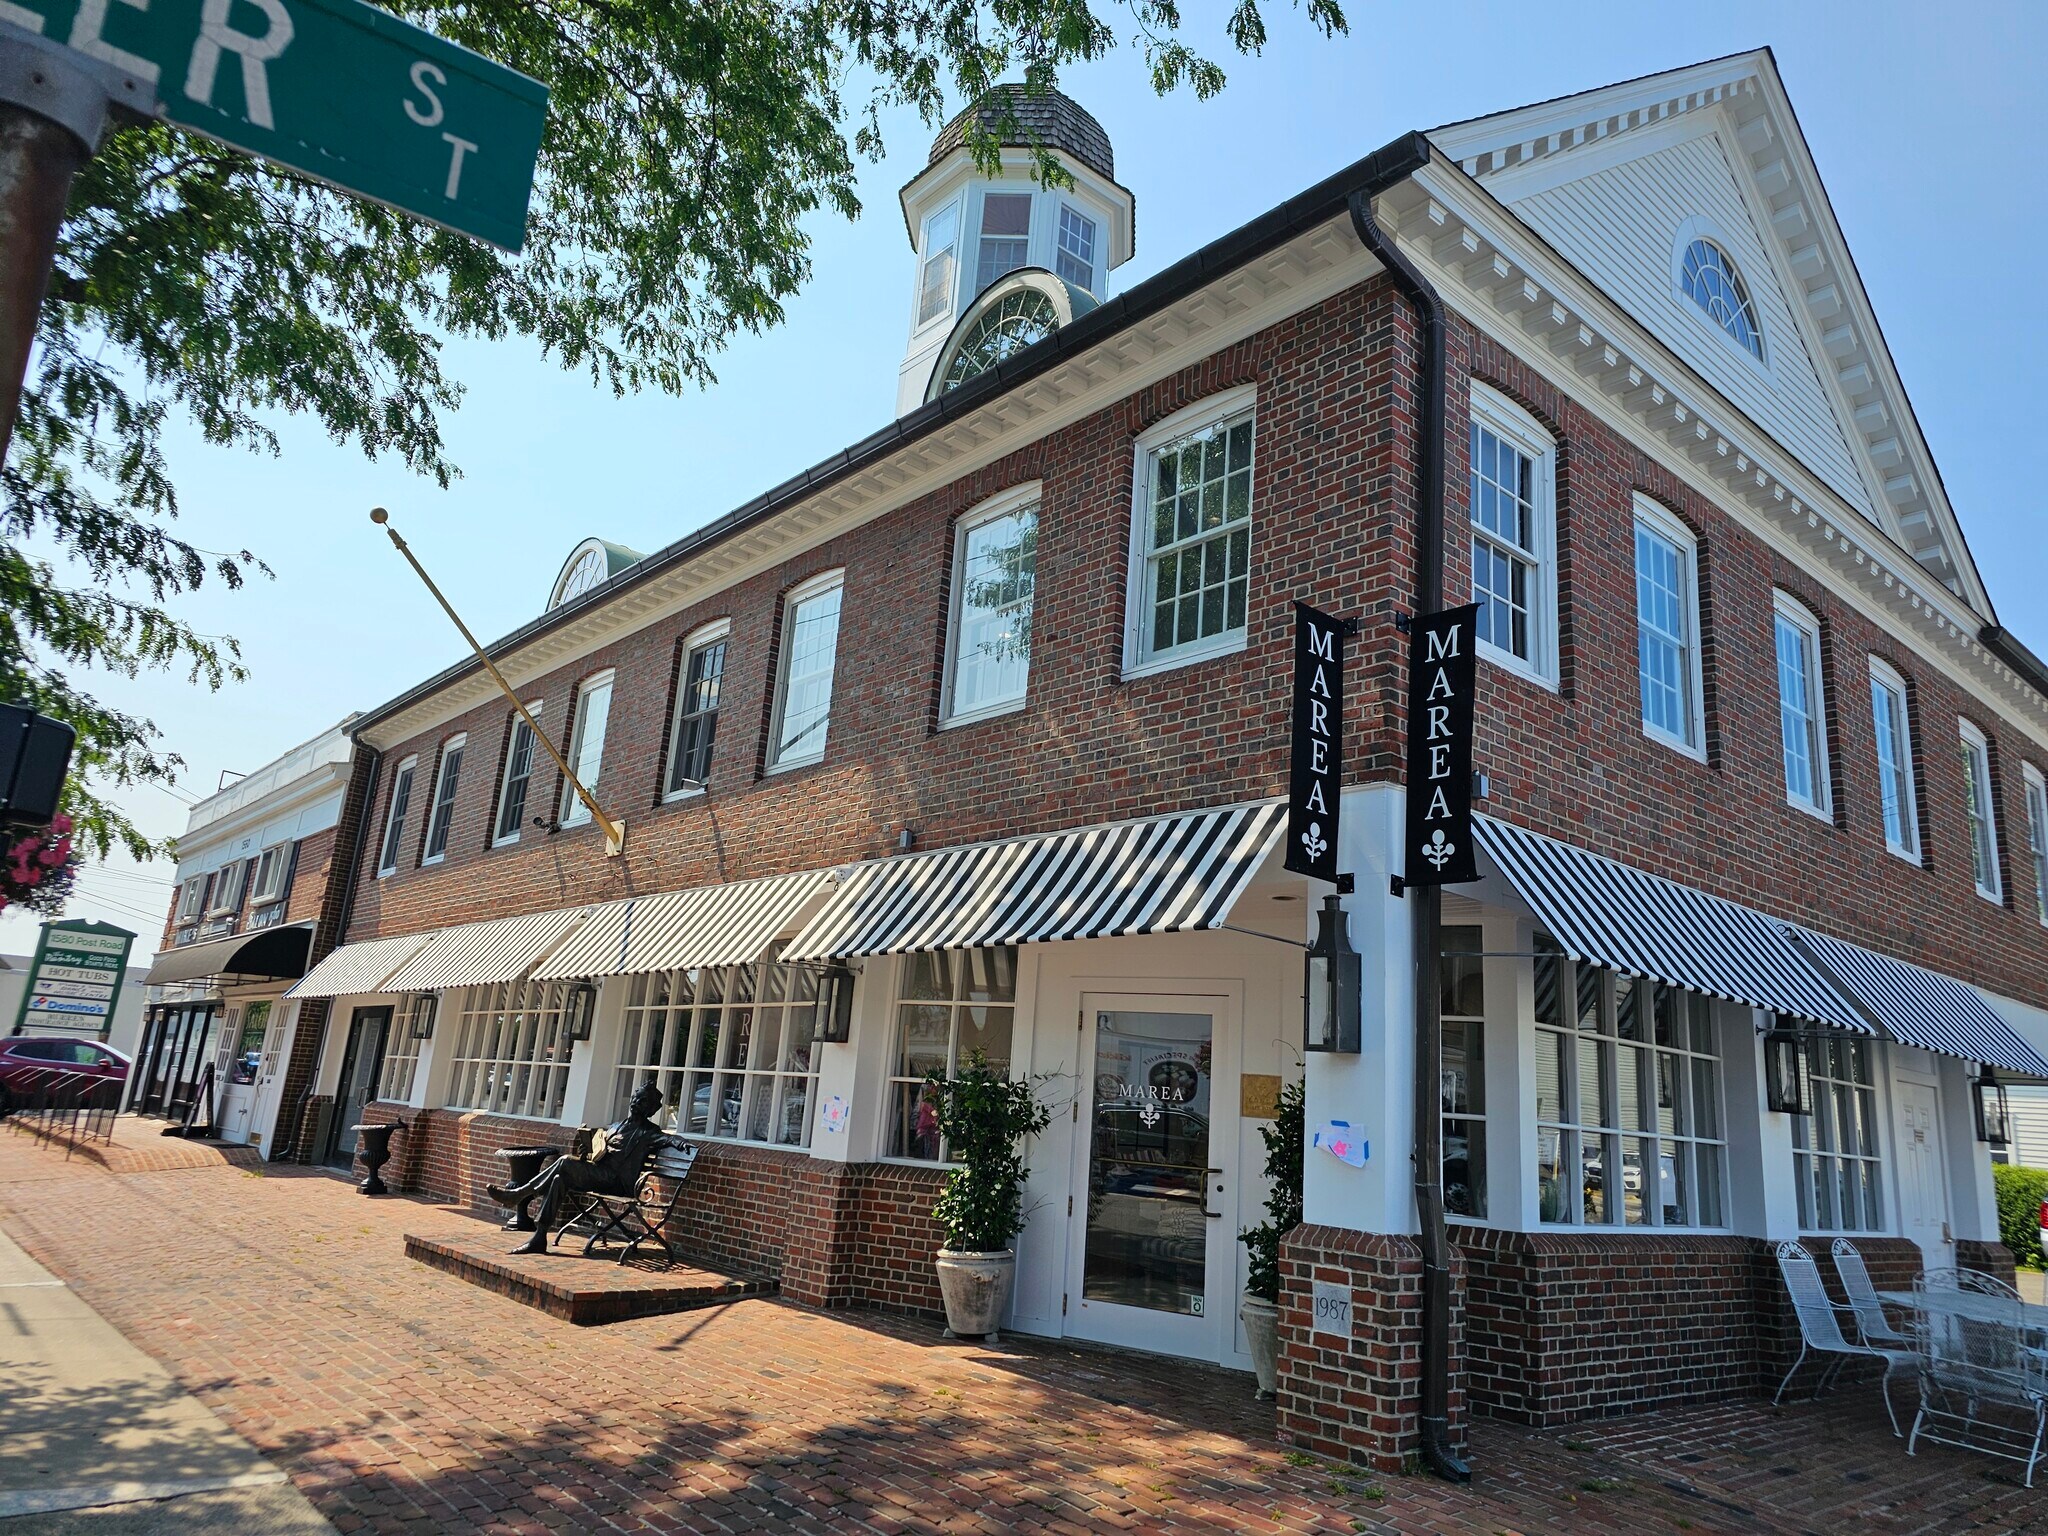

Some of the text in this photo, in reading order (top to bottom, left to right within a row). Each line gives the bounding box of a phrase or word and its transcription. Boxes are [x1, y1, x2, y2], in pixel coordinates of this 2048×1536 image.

[0, 0, 479, 201] ER ST
[1307, 621, 1335, 816] MAREA
[1424, 623, 1462, 821] MAREA
[50, 934, 123, 950] 1580 Post Road
[44, 953, 83, 965] Pantry
[48, 968, 110, 981] HOT TUBS
[47, 1001, 104, 1013] Domino's
[1118, 1083, 1184, 1101] MAREA
[1315, 1296, 1348, 1321] 1987
